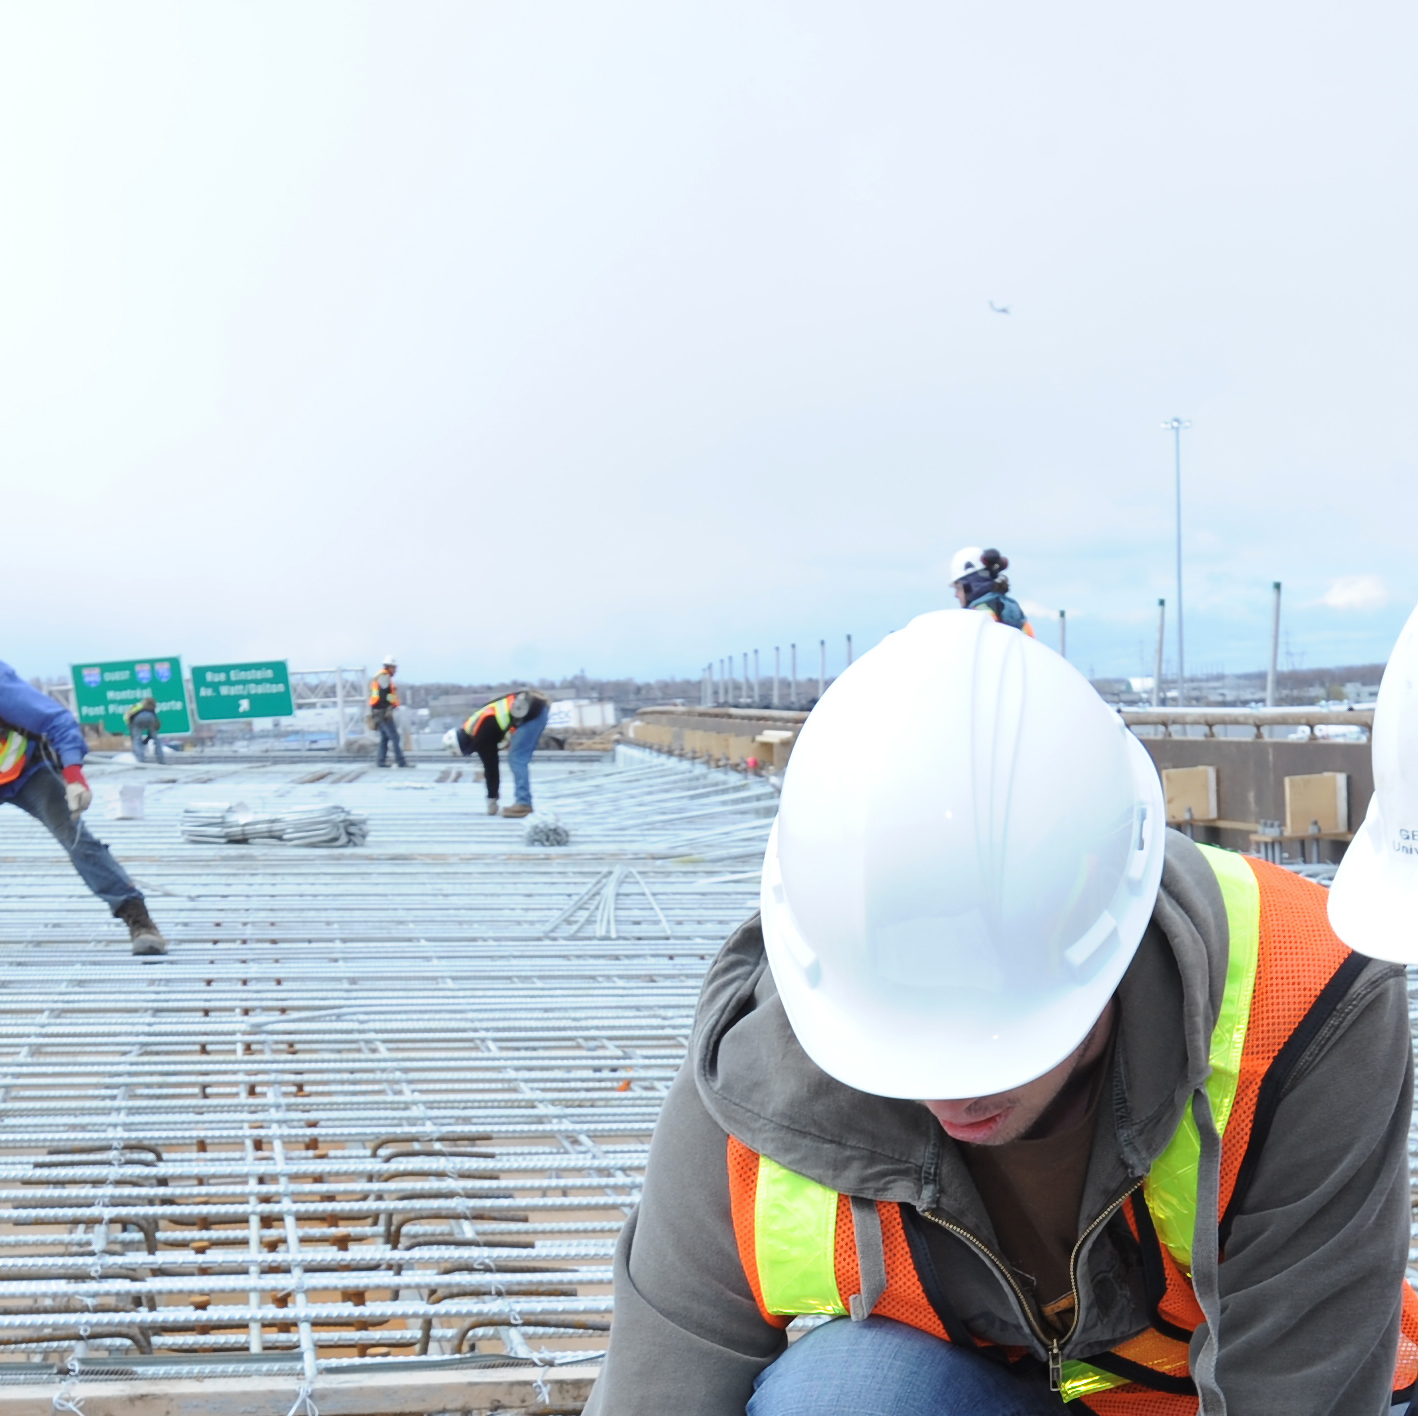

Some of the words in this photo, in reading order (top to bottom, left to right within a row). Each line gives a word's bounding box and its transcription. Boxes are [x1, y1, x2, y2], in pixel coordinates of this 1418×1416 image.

[104, 671, 130, 682] OUEST
[206, 671, 227, 682] Rue
[230, 668, 274, 681] Einstein
[106, 688, 152, 701] Montréal
[220, 682, 285, 696] Watt/Dalton
[82, 704, 105, 716] Pont
